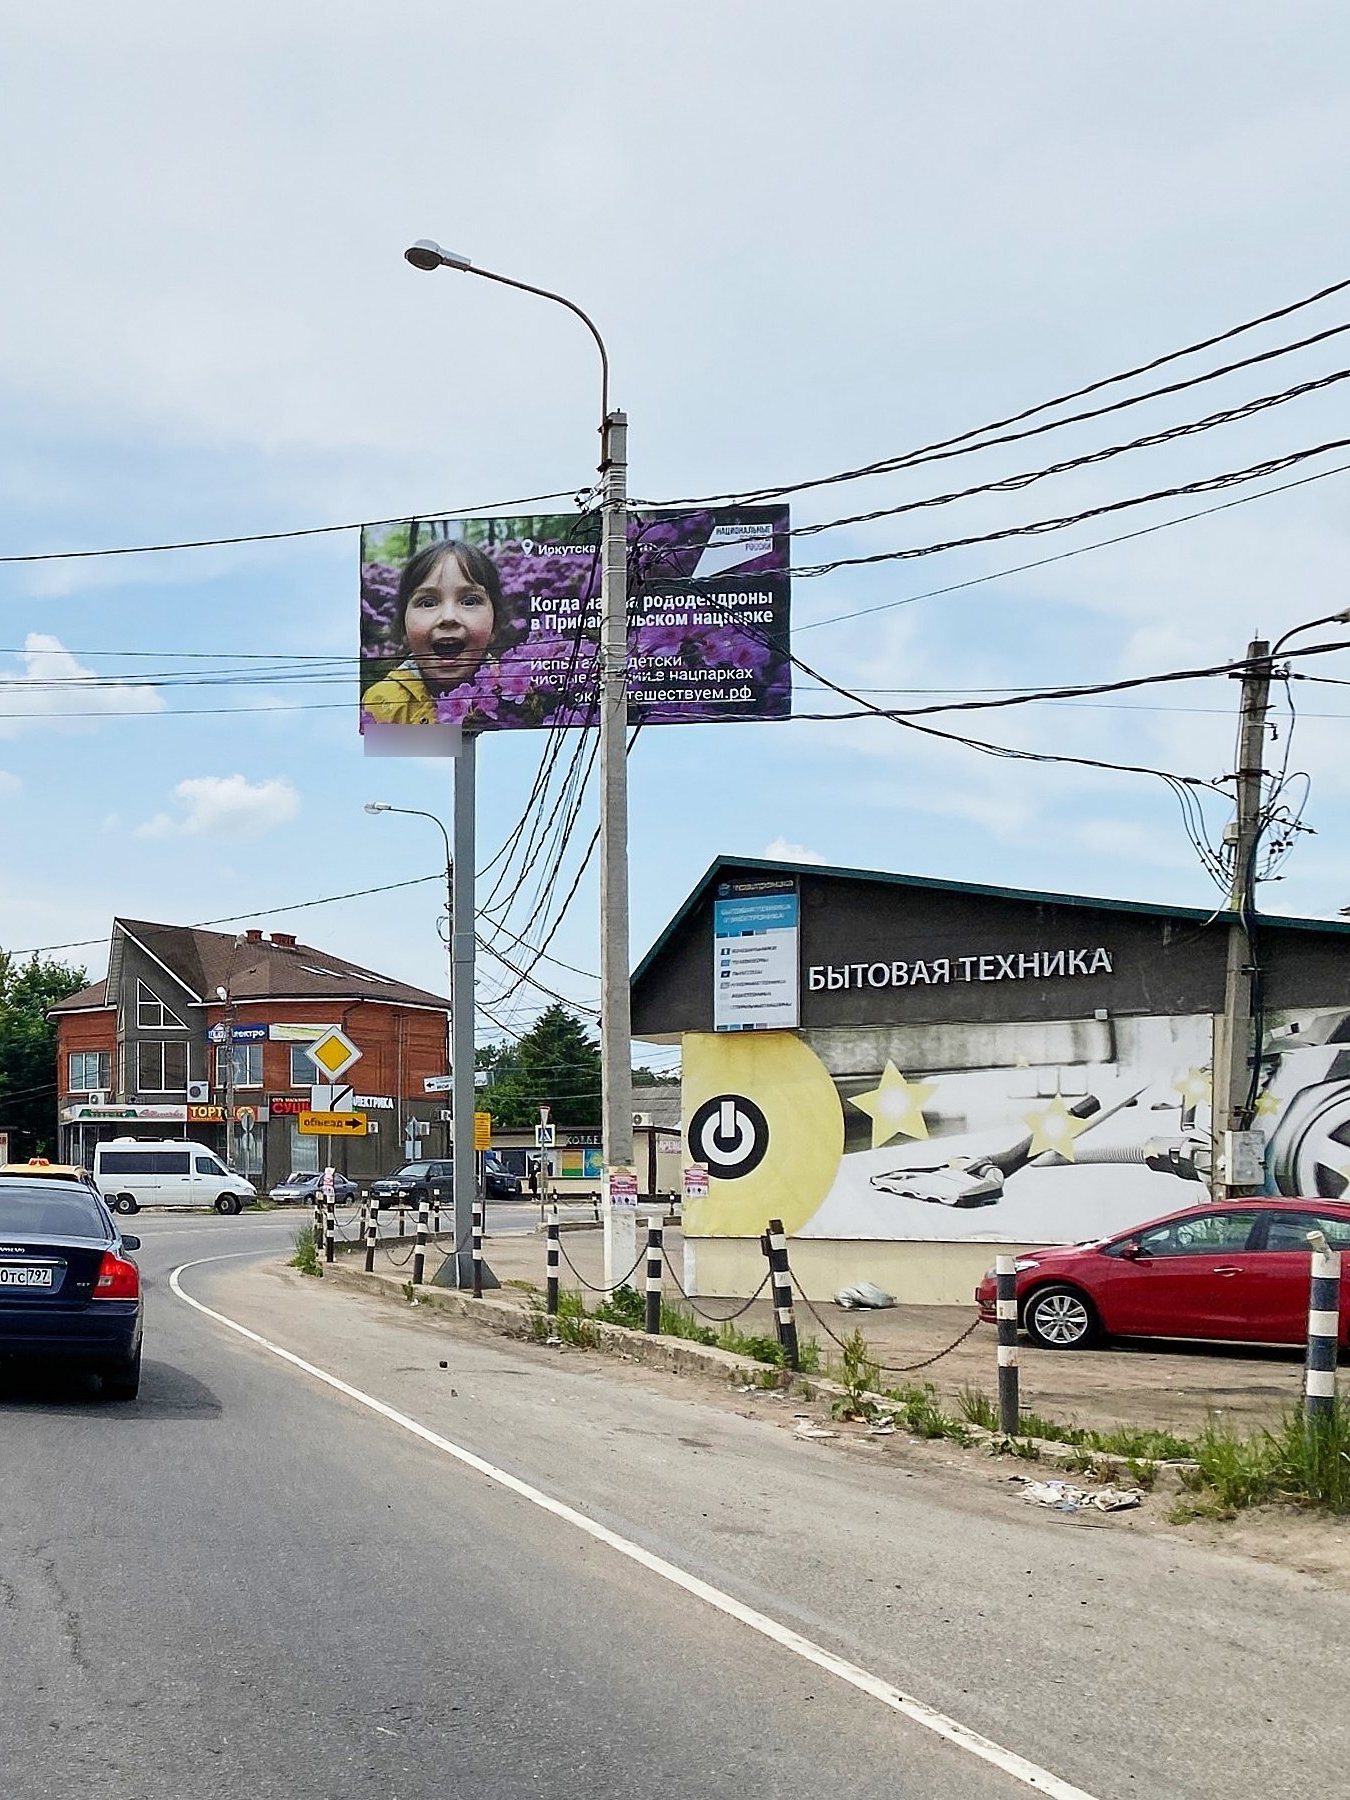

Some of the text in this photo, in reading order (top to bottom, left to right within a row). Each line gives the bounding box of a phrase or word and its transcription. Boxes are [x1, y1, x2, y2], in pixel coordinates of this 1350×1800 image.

[538, 544, 596, 556] Иркутска
[531, 596, 581, 613] Когда
[643, 591, 773, 611] рододендроны
[531, 618, 540, 630] в
[628, 655, 682, 671] детски
[670, 667, 753, 683] нацпарках
[808, 947, 1113, 991] БЫТОВАЯ ТЕХНИКА
